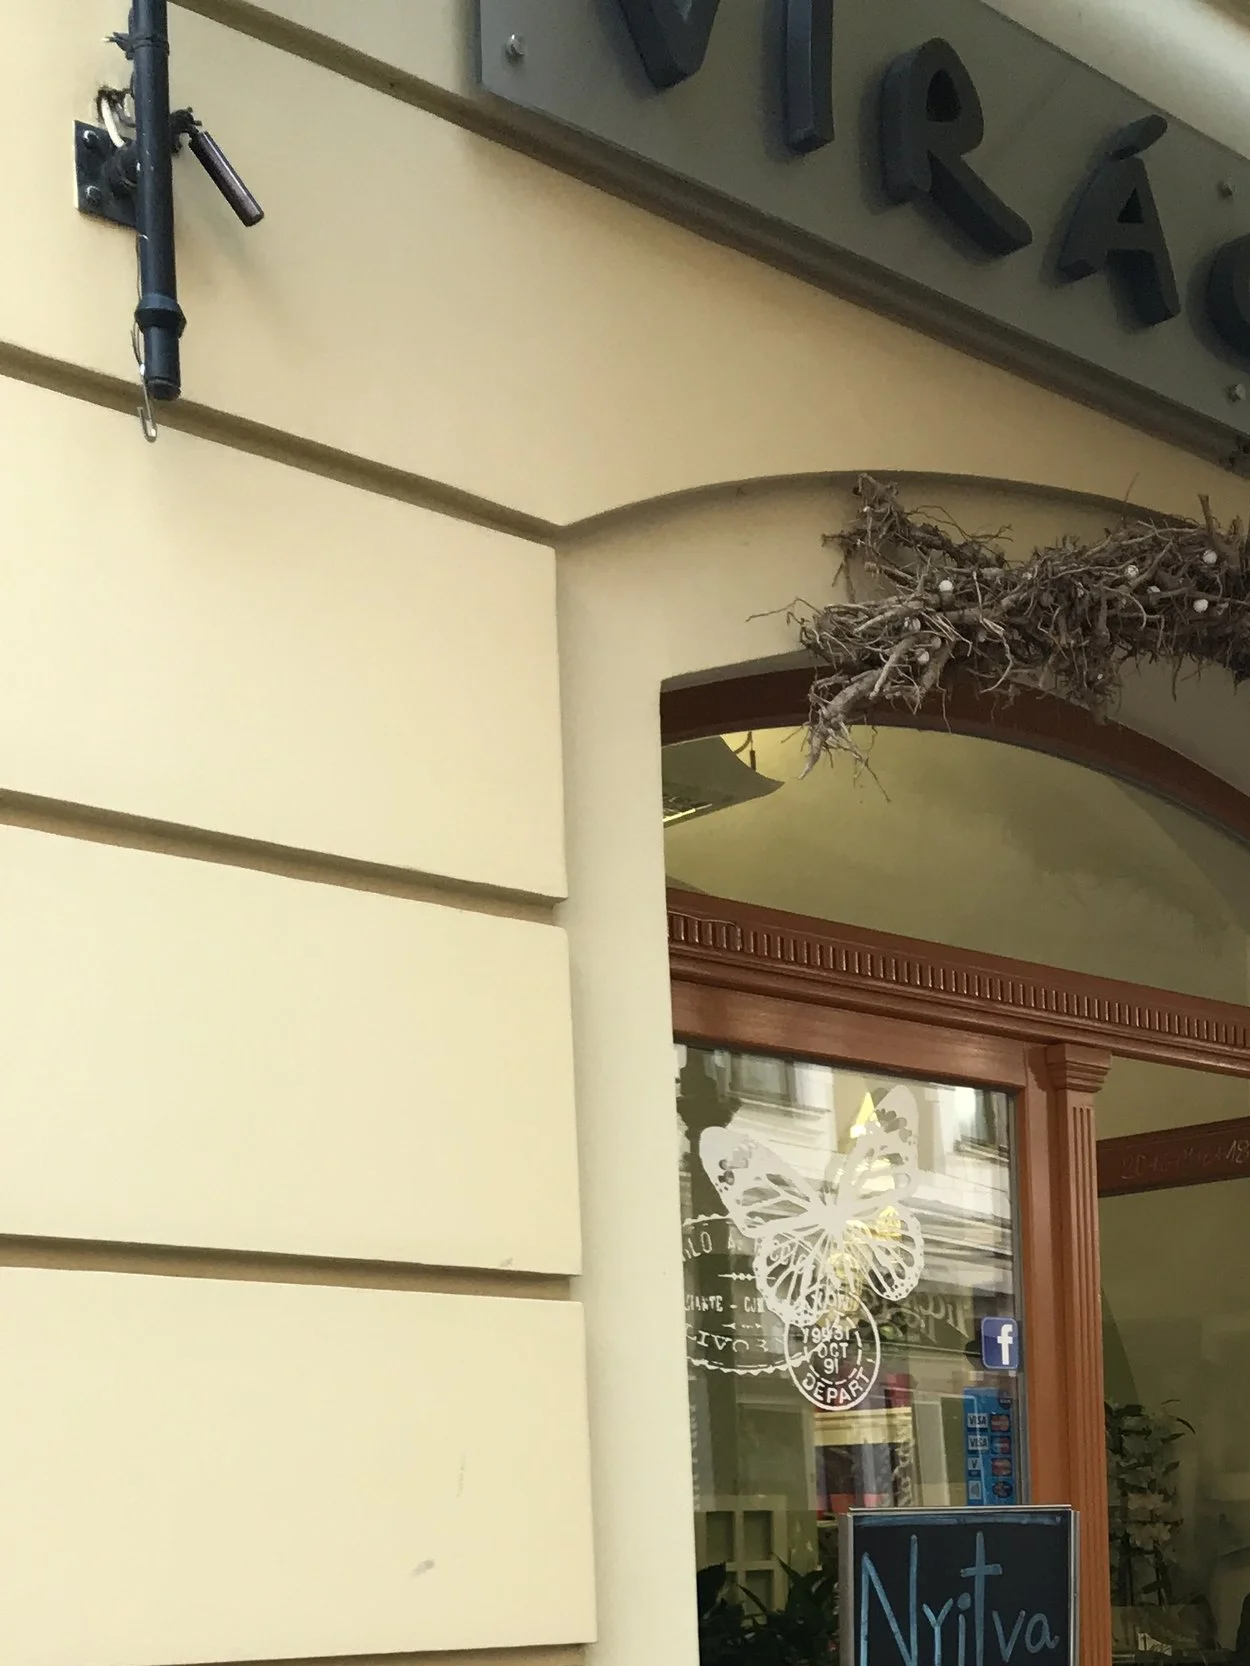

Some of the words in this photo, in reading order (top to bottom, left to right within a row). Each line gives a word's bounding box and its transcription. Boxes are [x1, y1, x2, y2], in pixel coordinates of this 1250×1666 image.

[817, 1342, 849, 1359] OCT
[823, 1357, 839, 1375] 91
[801, 1366, 870, 1404] DEPART
[967, 1412, 988, 1427] VISA
[968, 1434, 989, 1449] VISA
